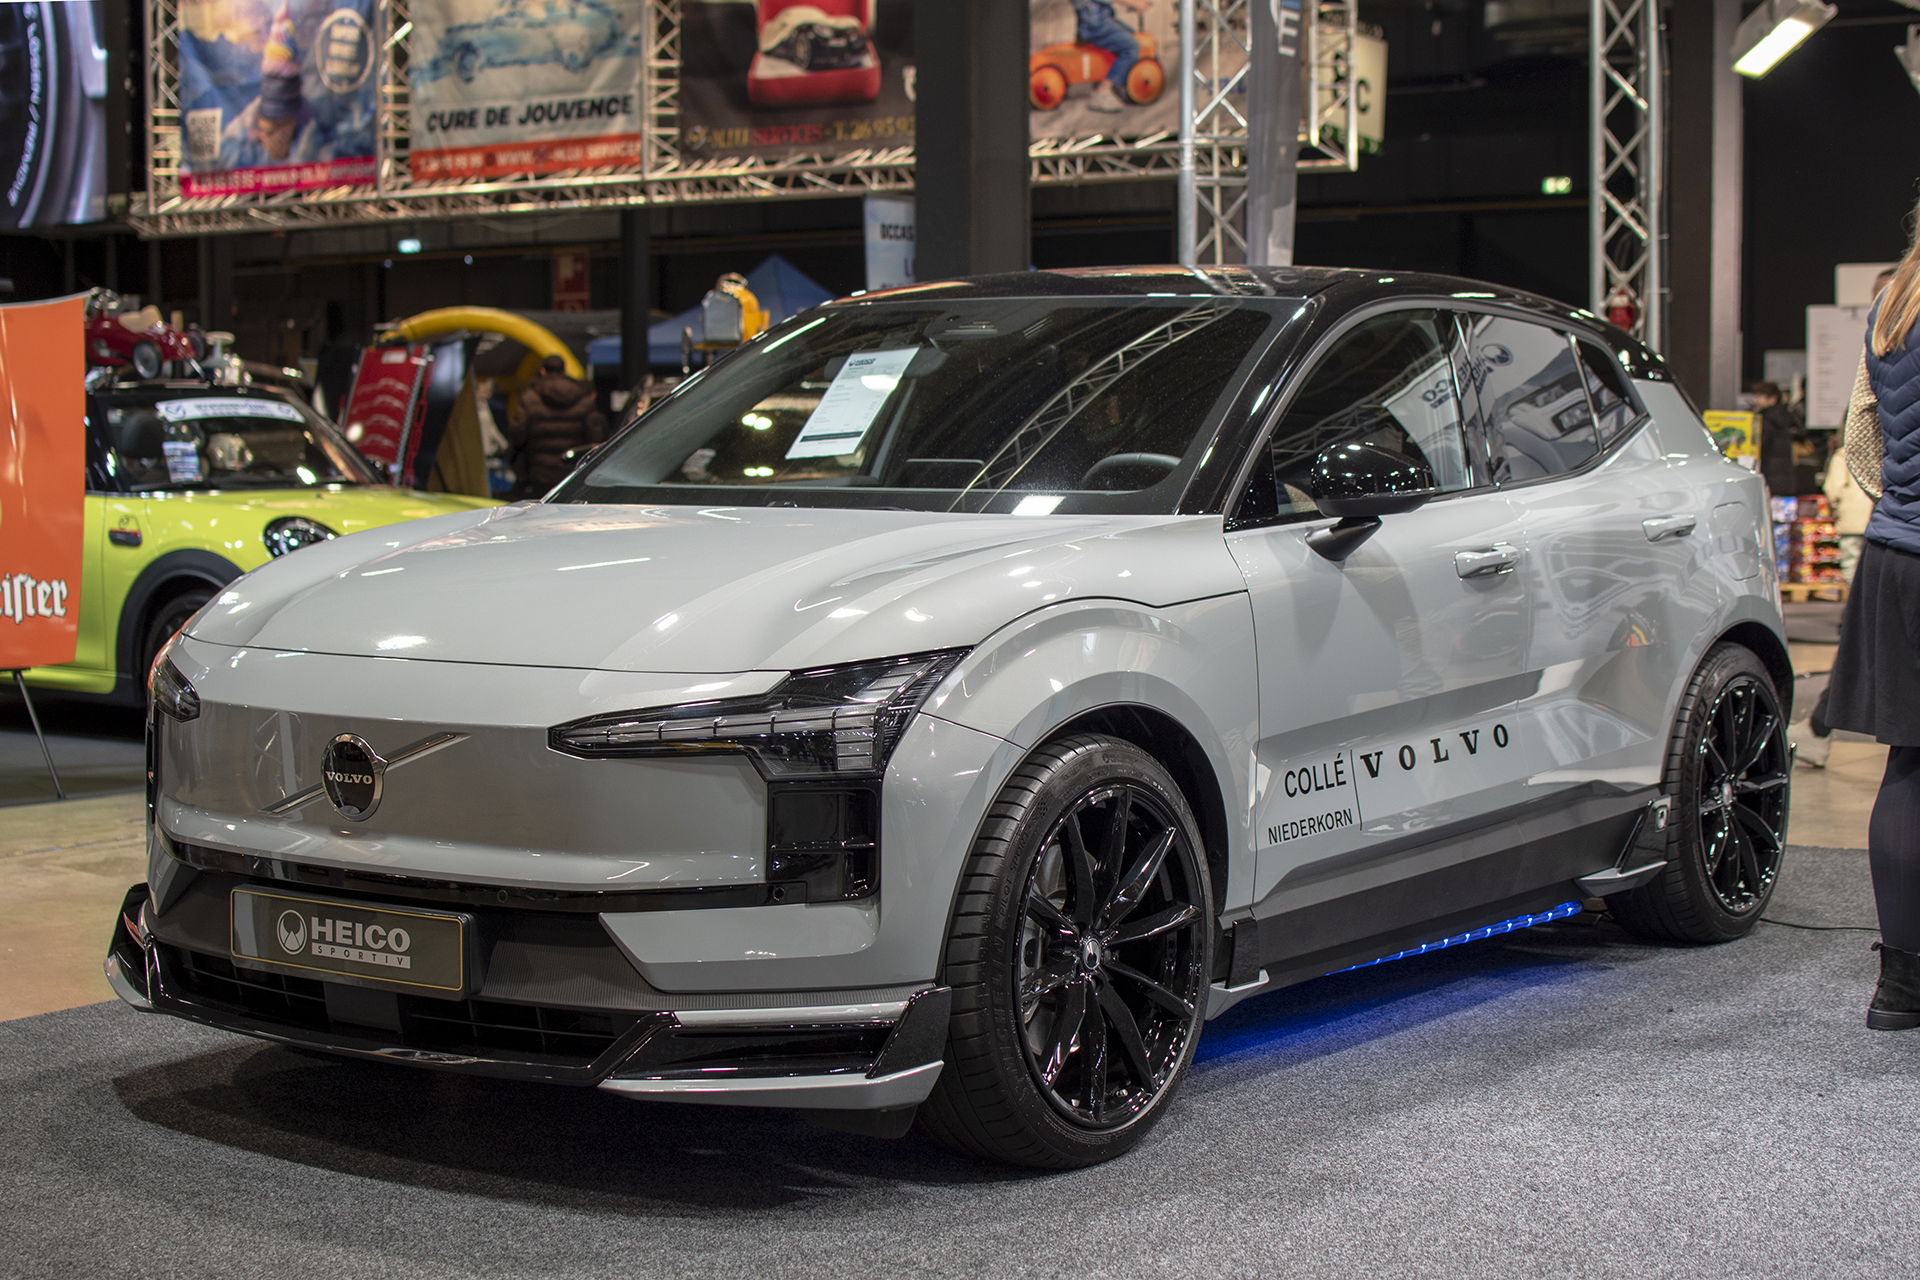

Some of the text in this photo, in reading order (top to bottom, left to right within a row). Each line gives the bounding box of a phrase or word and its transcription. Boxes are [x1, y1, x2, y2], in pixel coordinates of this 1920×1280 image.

[427, 95, 633, 132] CURE DE JOUVENCE
[0, 572, 68, 625] ister
[325, 771, 373, 785] VOLVO
[1284, 723, 1509, 798] COLLÉ VOLVO
[1268, 808, 1353, 845] NIEDERKORN
[999, 878, 1013, 917] PILOT
[1010, 833, 1030, 872] SPORT
[311, 916, 411, 953] HEICO
[317, 944, 404, 966] SPORTIV
